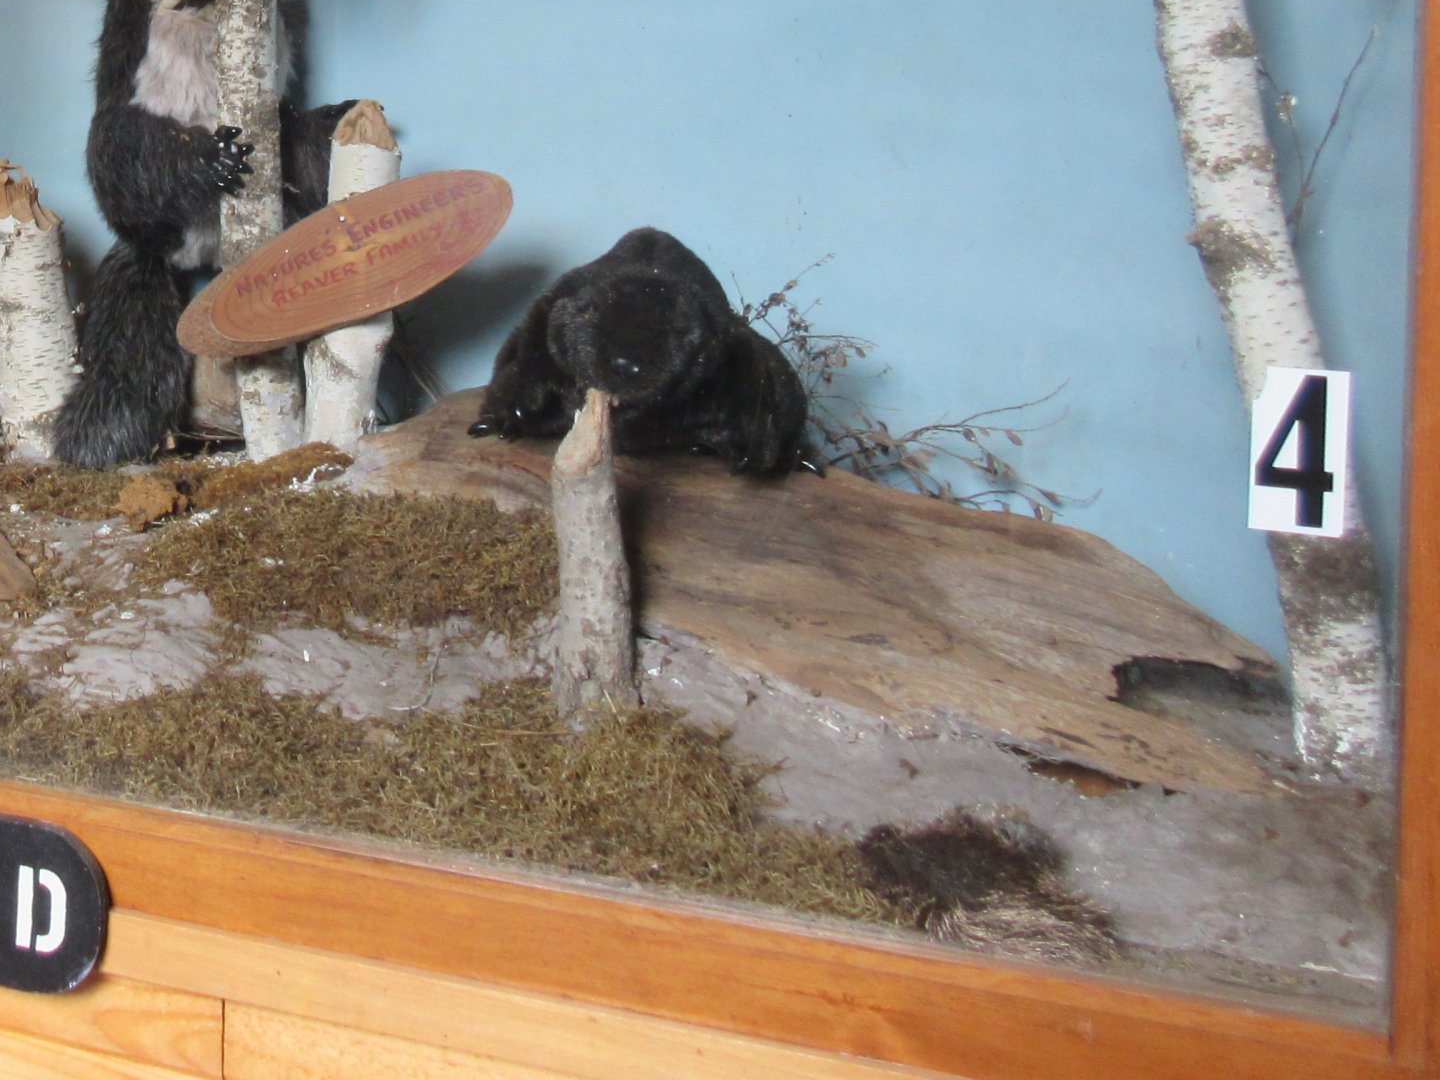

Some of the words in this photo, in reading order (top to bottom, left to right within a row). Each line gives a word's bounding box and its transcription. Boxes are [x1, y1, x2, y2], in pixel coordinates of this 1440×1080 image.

[345, 177, 485, 244] ENGINEERS
[271, 261, 359, 307] BEAVER
[366, 221, 444, 266] FAMILY
[1255, 374, 1334, 529] 4
